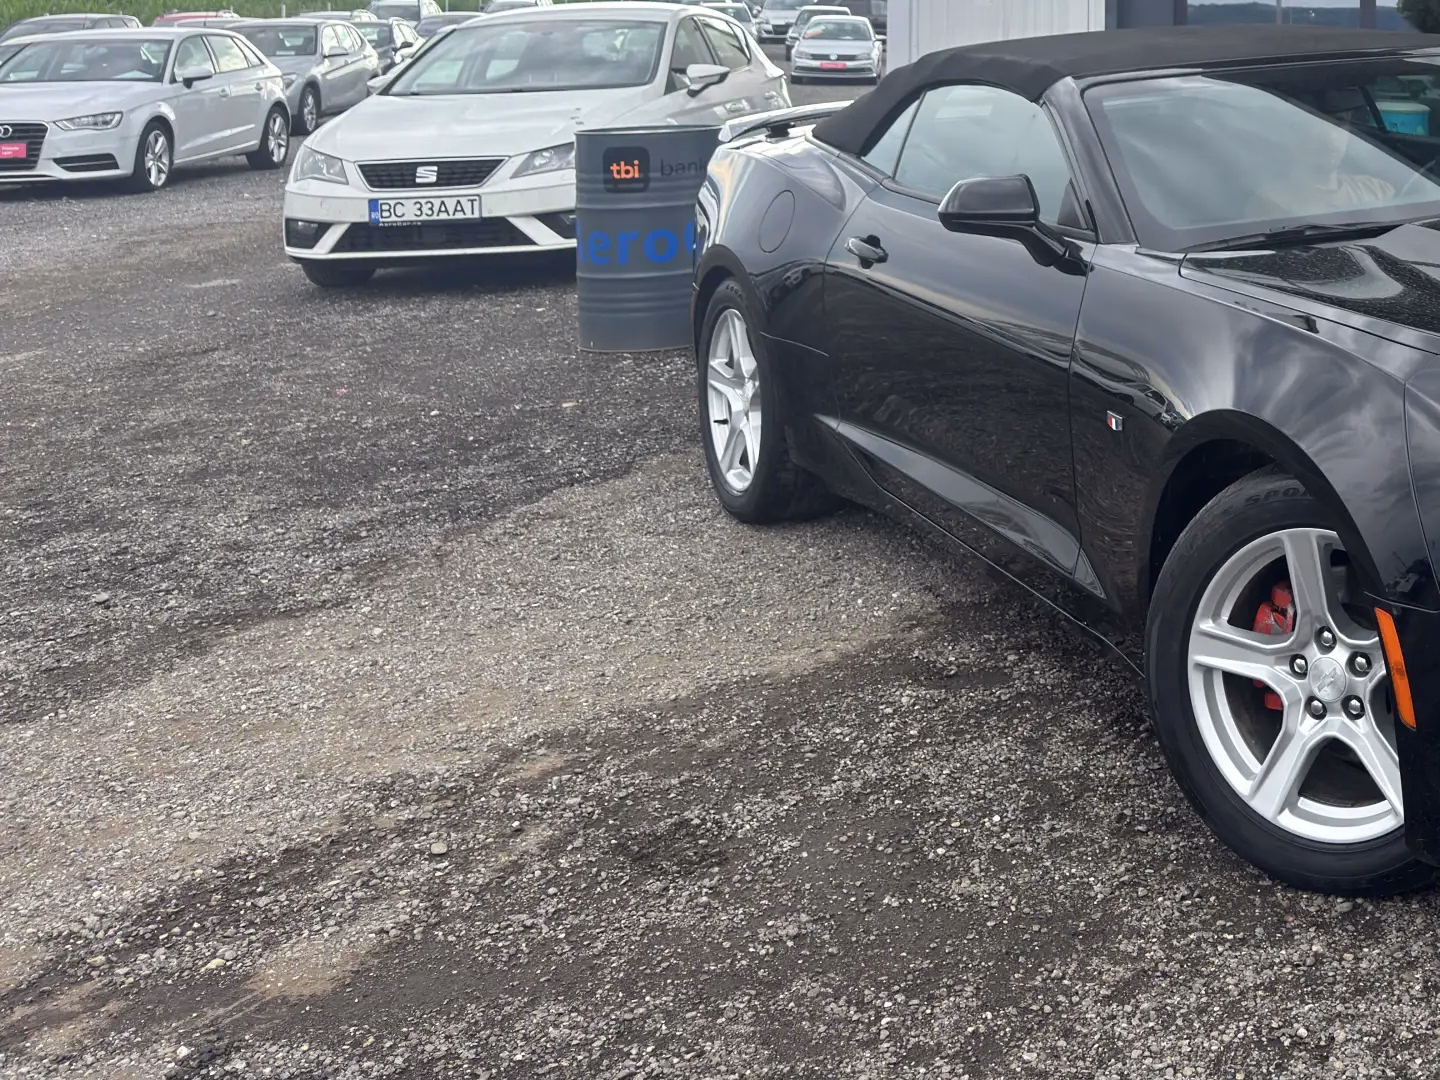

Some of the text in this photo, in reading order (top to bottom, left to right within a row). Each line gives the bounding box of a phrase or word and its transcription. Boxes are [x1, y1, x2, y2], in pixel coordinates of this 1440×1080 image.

[610, 160, 639, 179] tbi
[379, 198, 478, 219] BC 33AAT
[576, 218, 695, 265] ero
